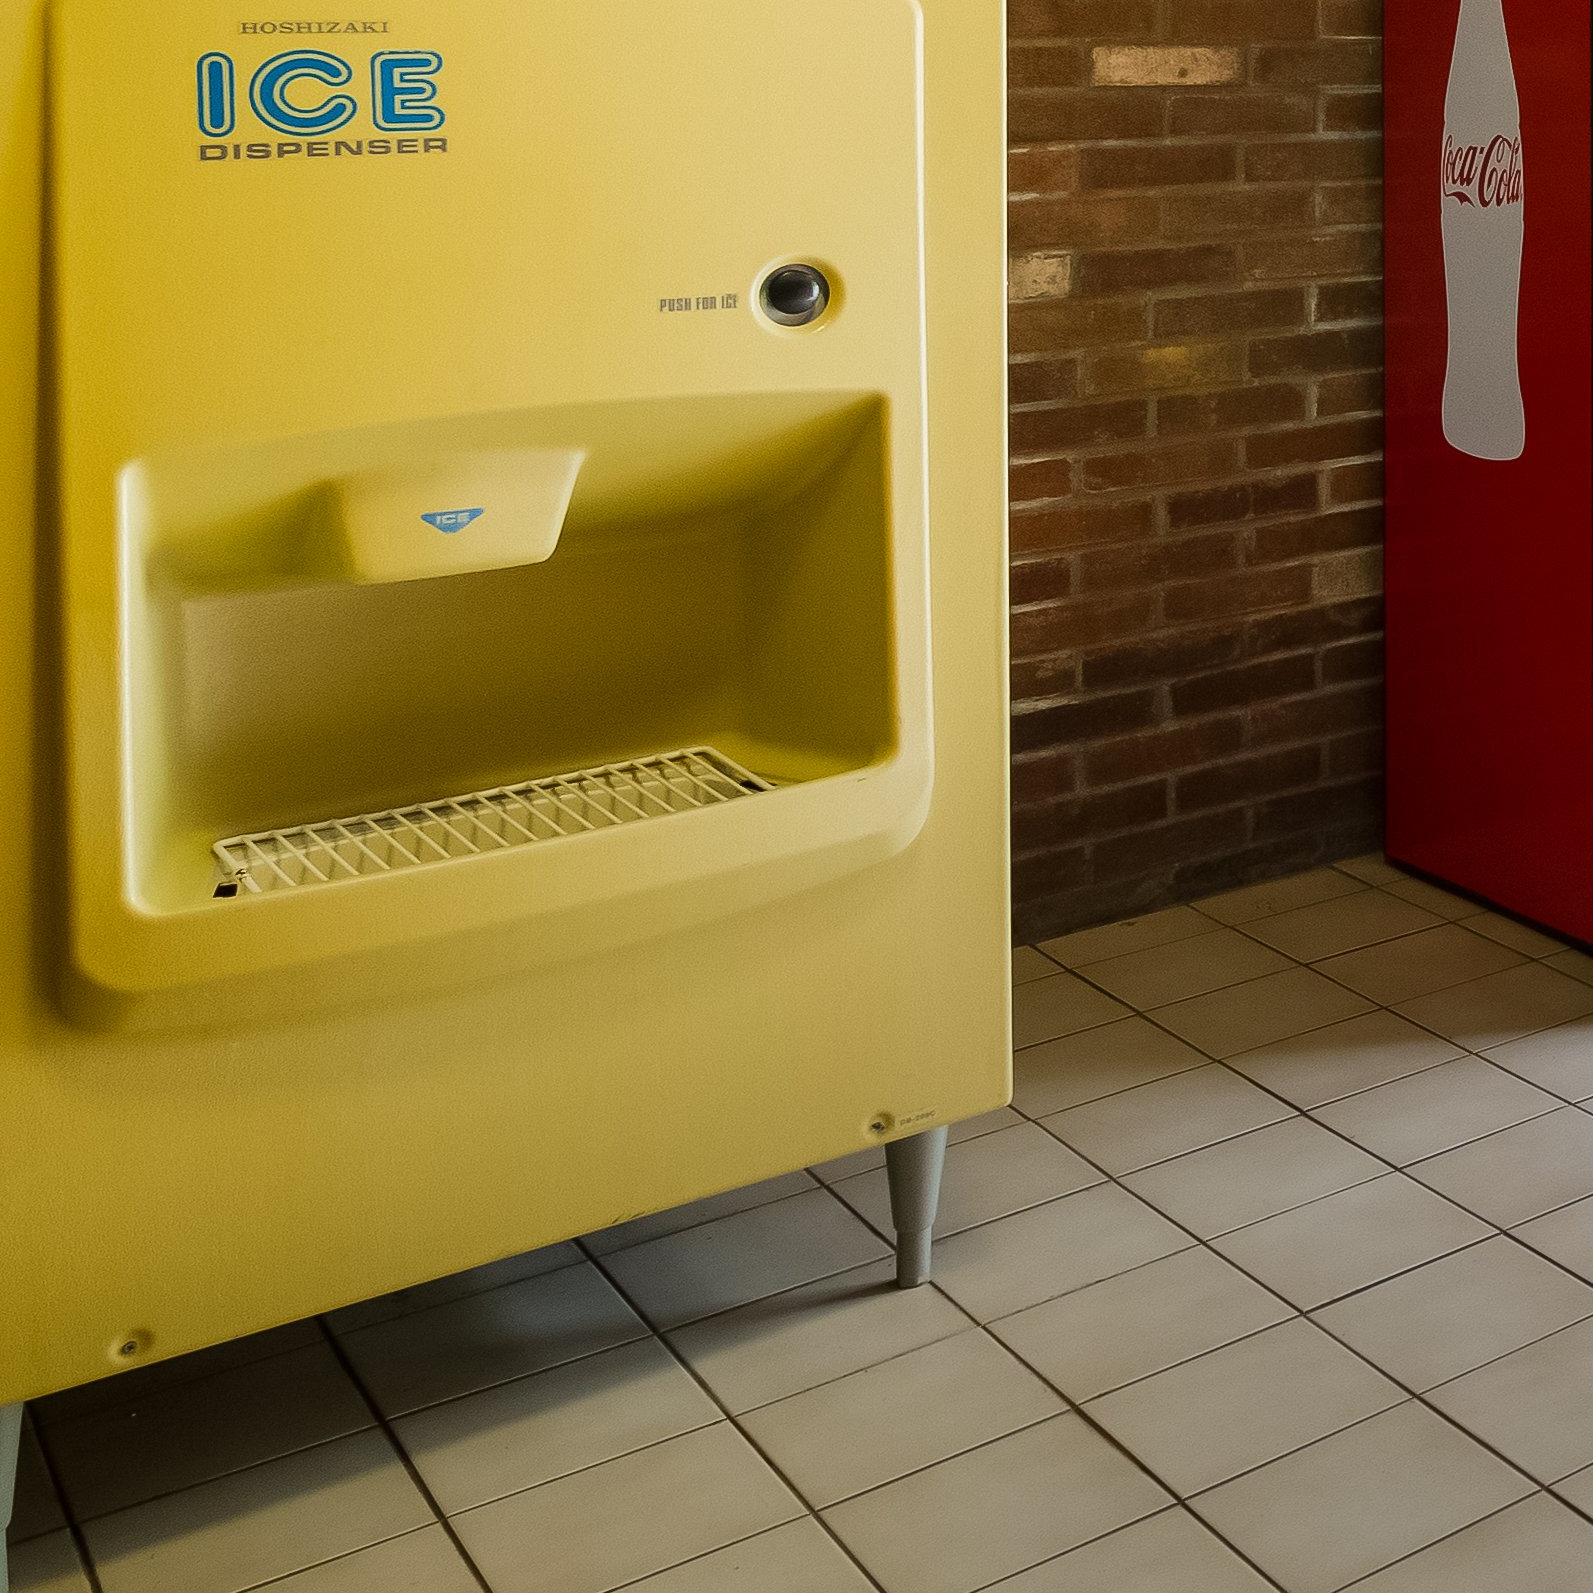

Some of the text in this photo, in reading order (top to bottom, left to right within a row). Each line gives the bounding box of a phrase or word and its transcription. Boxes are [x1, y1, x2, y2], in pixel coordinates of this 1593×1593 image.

[241, 21, 390, 34] HOSHIZAKI
[196, 49, 446, 137] ICE
[199, 137, 448, 162] DISPENSER
[1442, 135, 1522, 207] Coca-Cola
[659, 294, 737, 312] PUSH FOR ICE
[436, 512, 470, 525] ICE
